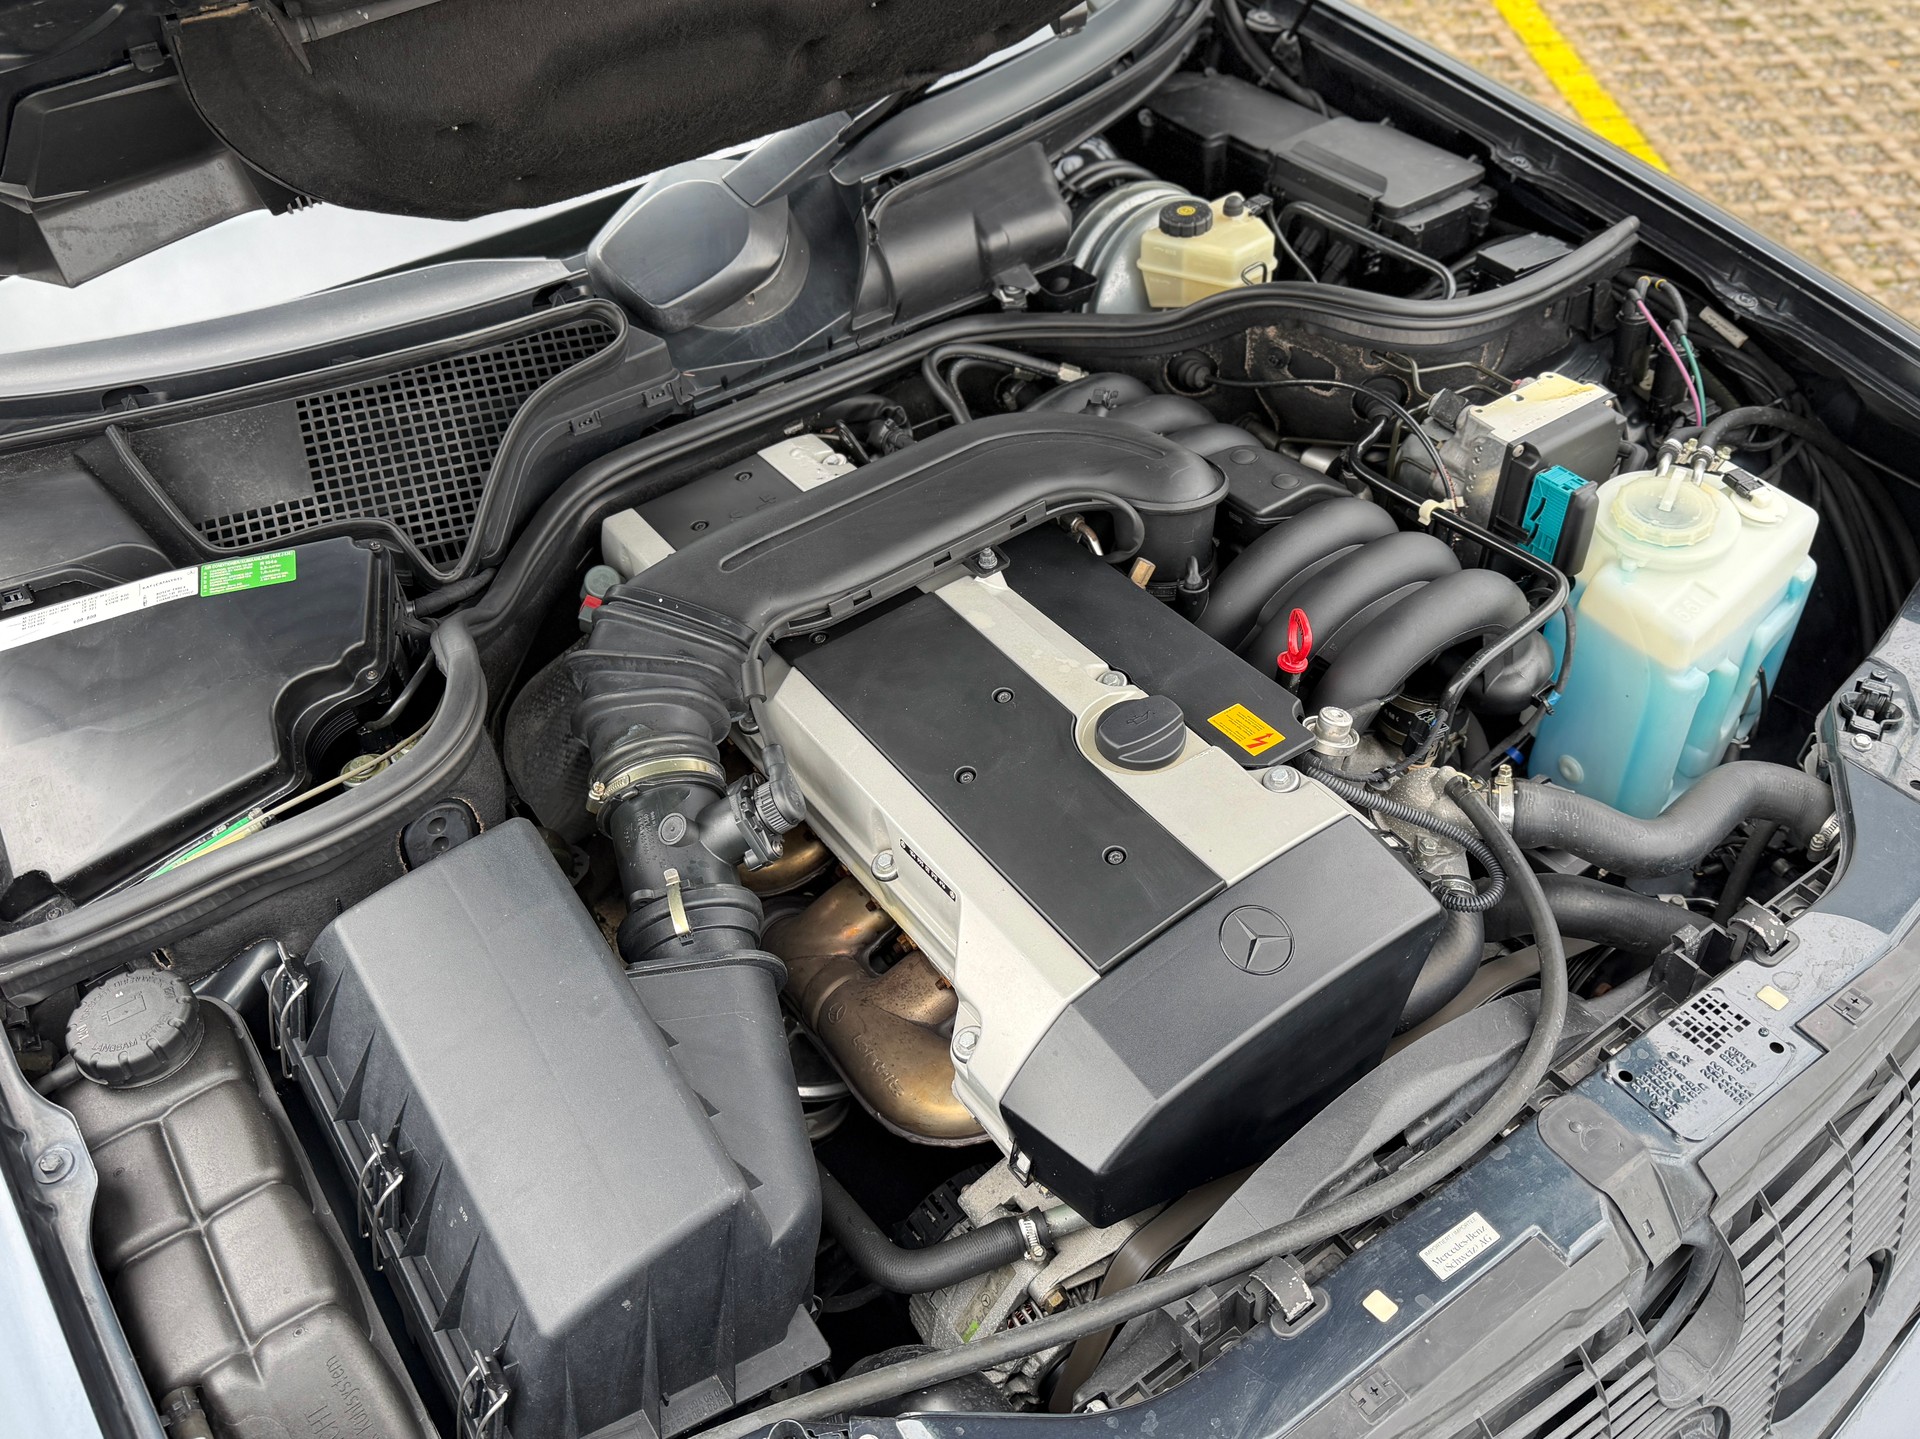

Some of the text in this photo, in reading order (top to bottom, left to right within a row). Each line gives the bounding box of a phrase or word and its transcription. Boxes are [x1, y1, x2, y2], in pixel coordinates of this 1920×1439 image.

[1432, 1226, 1488, 1267] Mercedes-Benz
[1444, 1234, 1493, 1272] (Schweiz) AG
[326, 1355, 373, 1436] Kühlsystem
